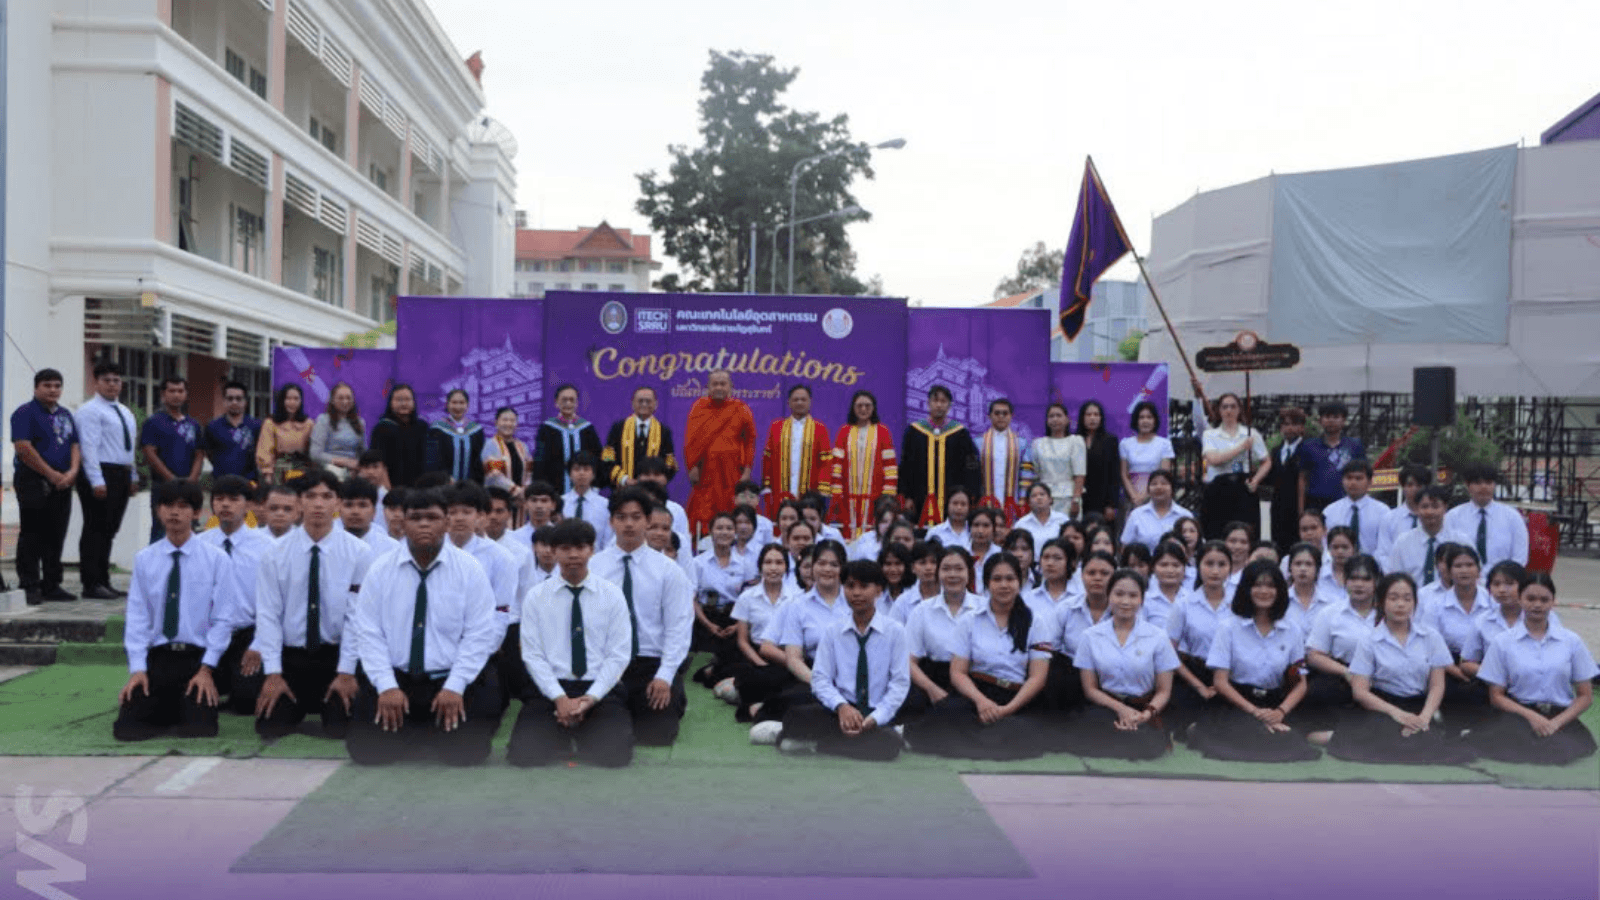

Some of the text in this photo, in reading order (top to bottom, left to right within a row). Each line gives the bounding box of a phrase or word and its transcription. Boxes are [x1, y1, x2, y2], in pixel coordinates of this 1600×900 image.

[676, 308, 818, 324] คณะเทคโนโลยีอุตสาหกรรม
[592, 347, 866, 386] Congratulations
